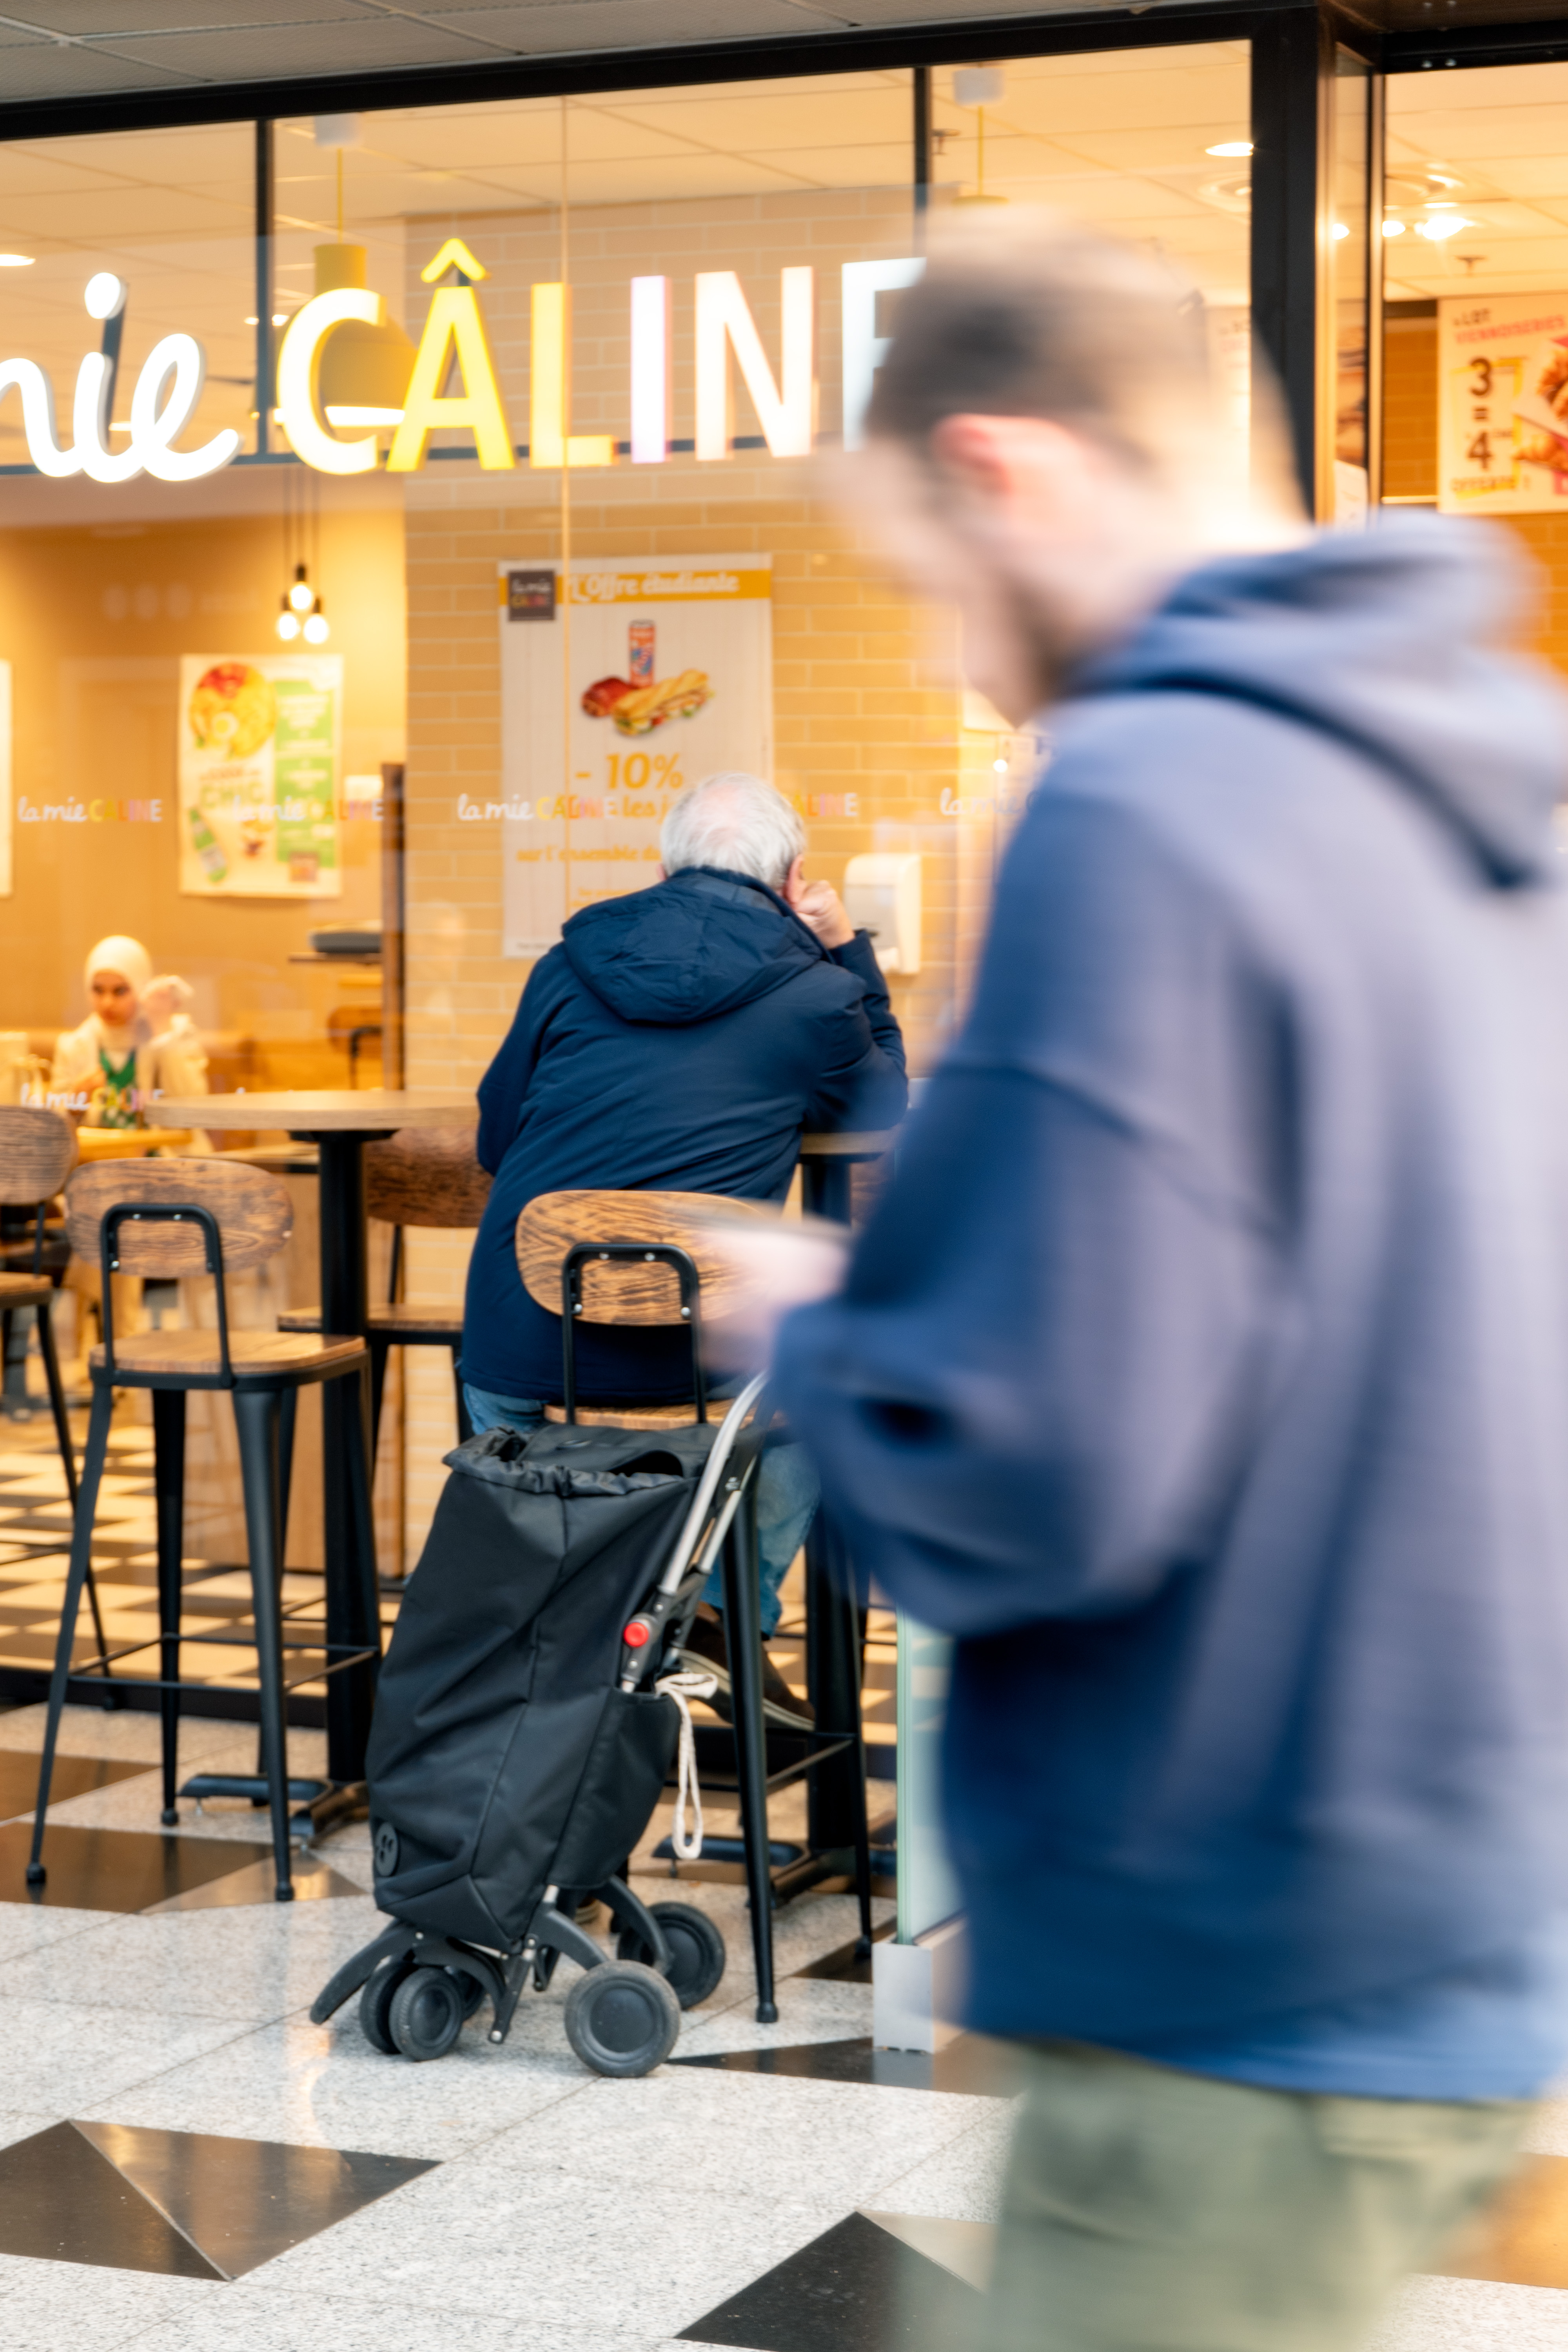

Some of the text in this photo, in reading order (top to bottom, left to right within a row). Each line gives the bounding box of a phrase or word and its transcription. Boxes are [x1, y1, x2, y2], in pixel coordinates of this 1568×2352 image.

[1469, 357, 1492, 397] 3
[1466, 430, 1493, 470] 4
[606, 752, 683, 790] 10%
[18, 796, 40, 822] la
[42, 796, 87, 822] mie
[458, 793, 483, 820] la
[485, 793, 534, 820] mie
